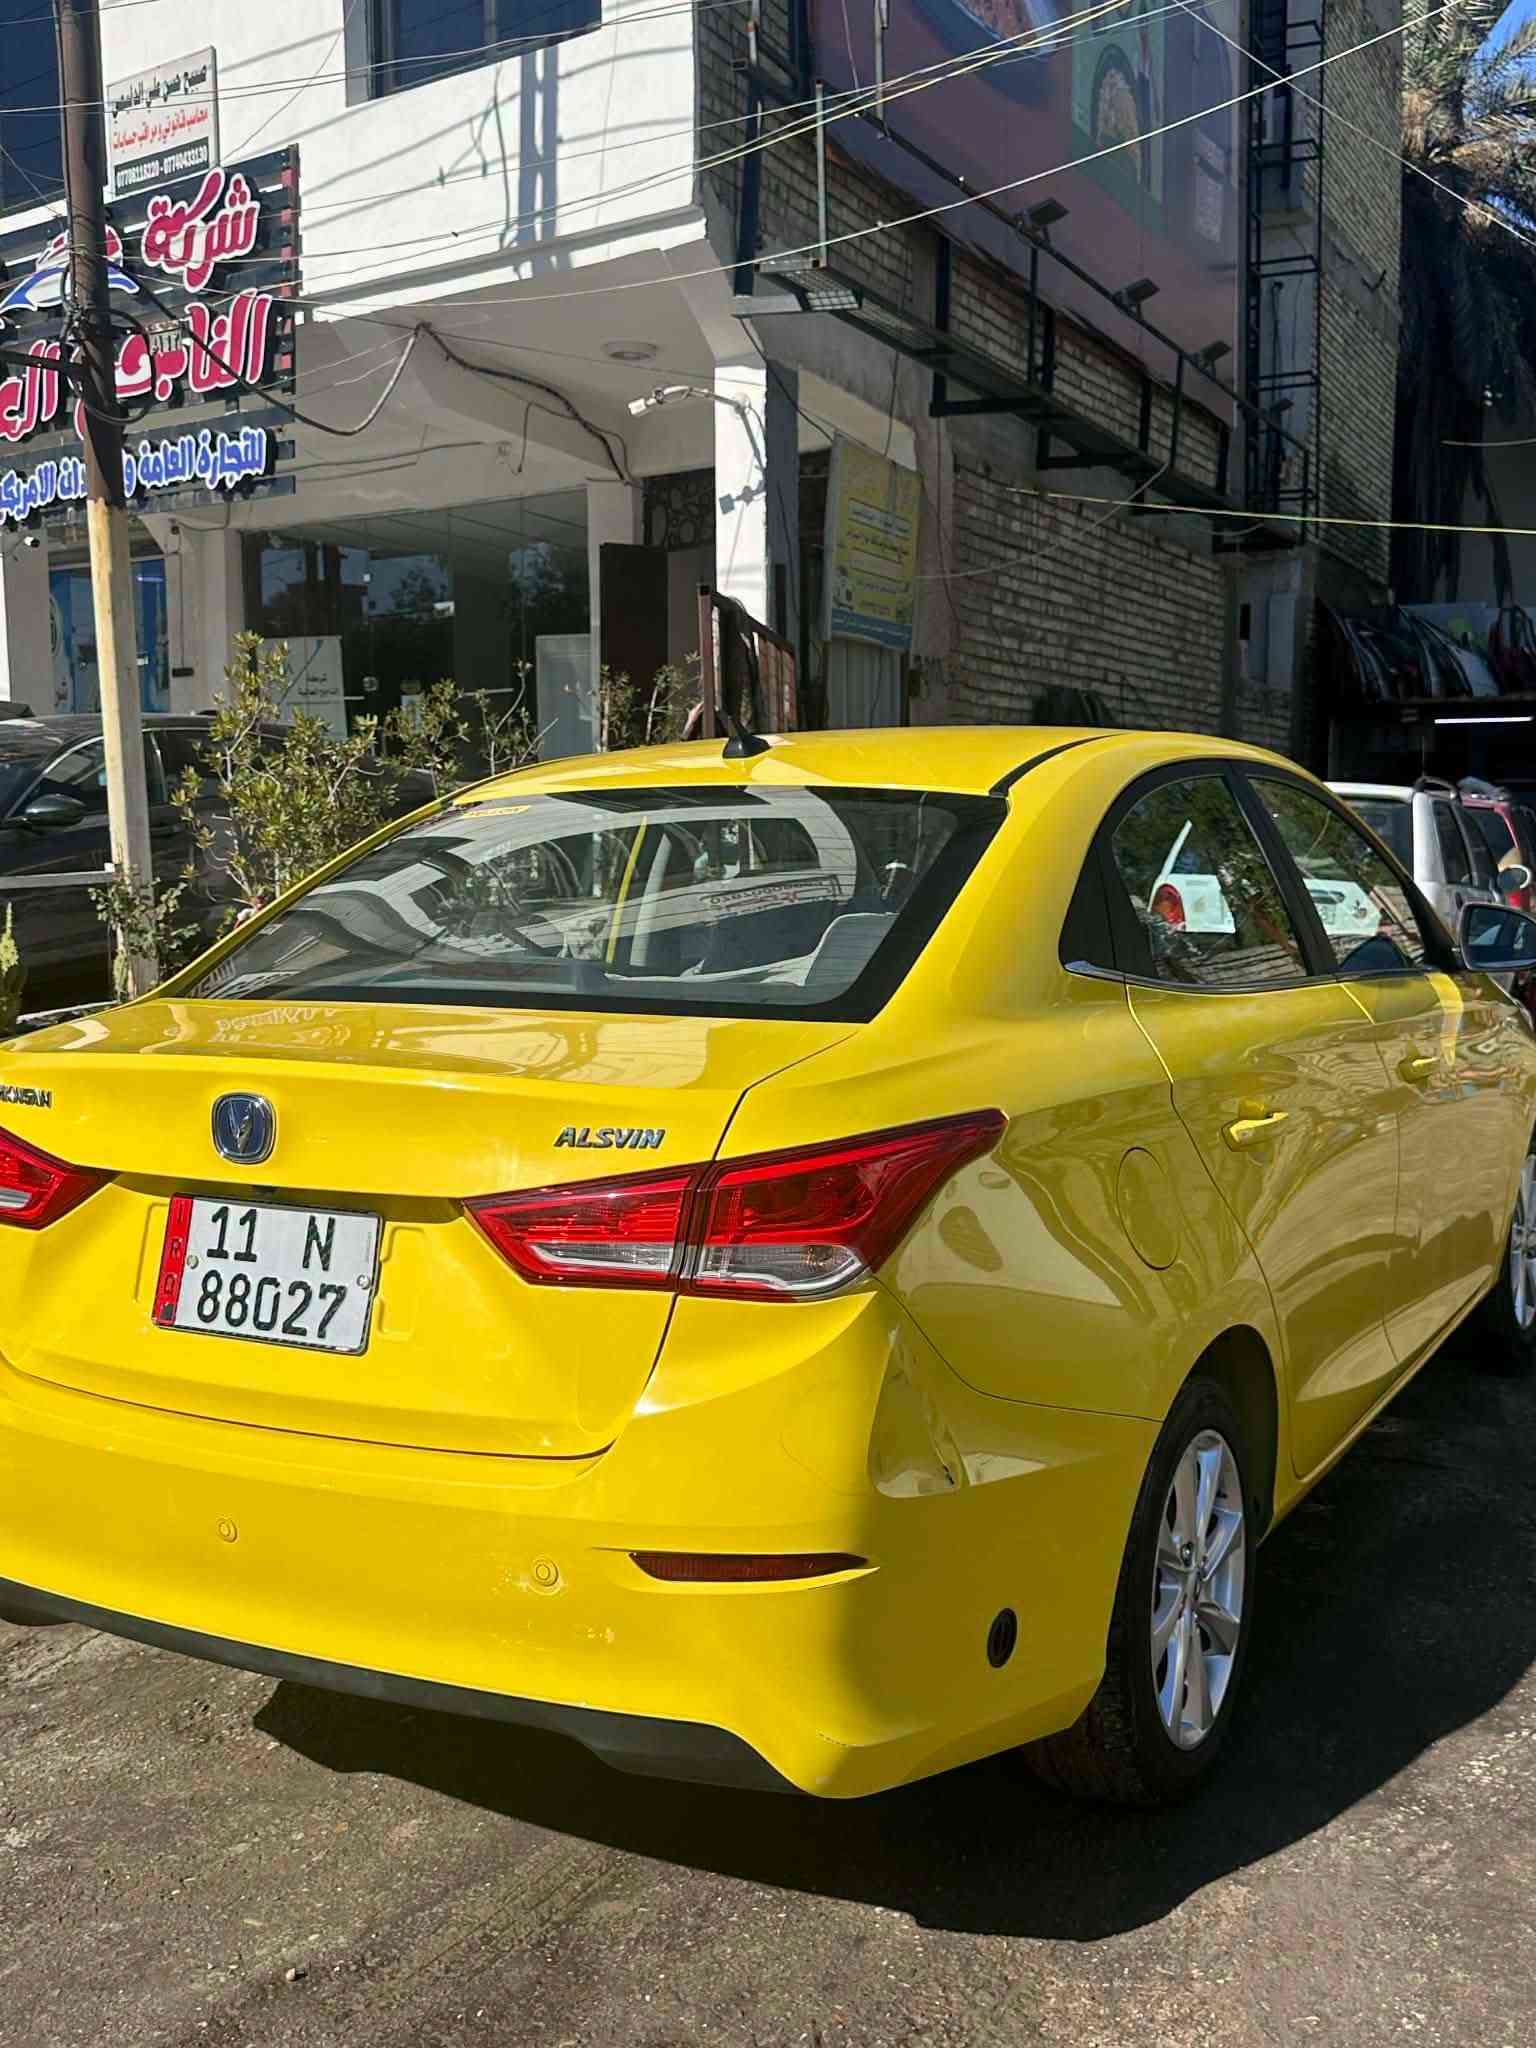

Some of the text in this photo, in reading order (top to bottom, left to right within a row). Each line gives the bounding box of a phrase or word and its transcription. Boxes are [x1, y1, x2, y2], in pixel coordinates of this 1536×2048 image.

[142, 168, 259, 292] شركة
[138, 435, 195, 488] العامة
[553, 1127, 666, 1149] ALSVIN
[206, 1206, 336, 1272] 11 N
[197, 1269, 347, 1339] 88027
